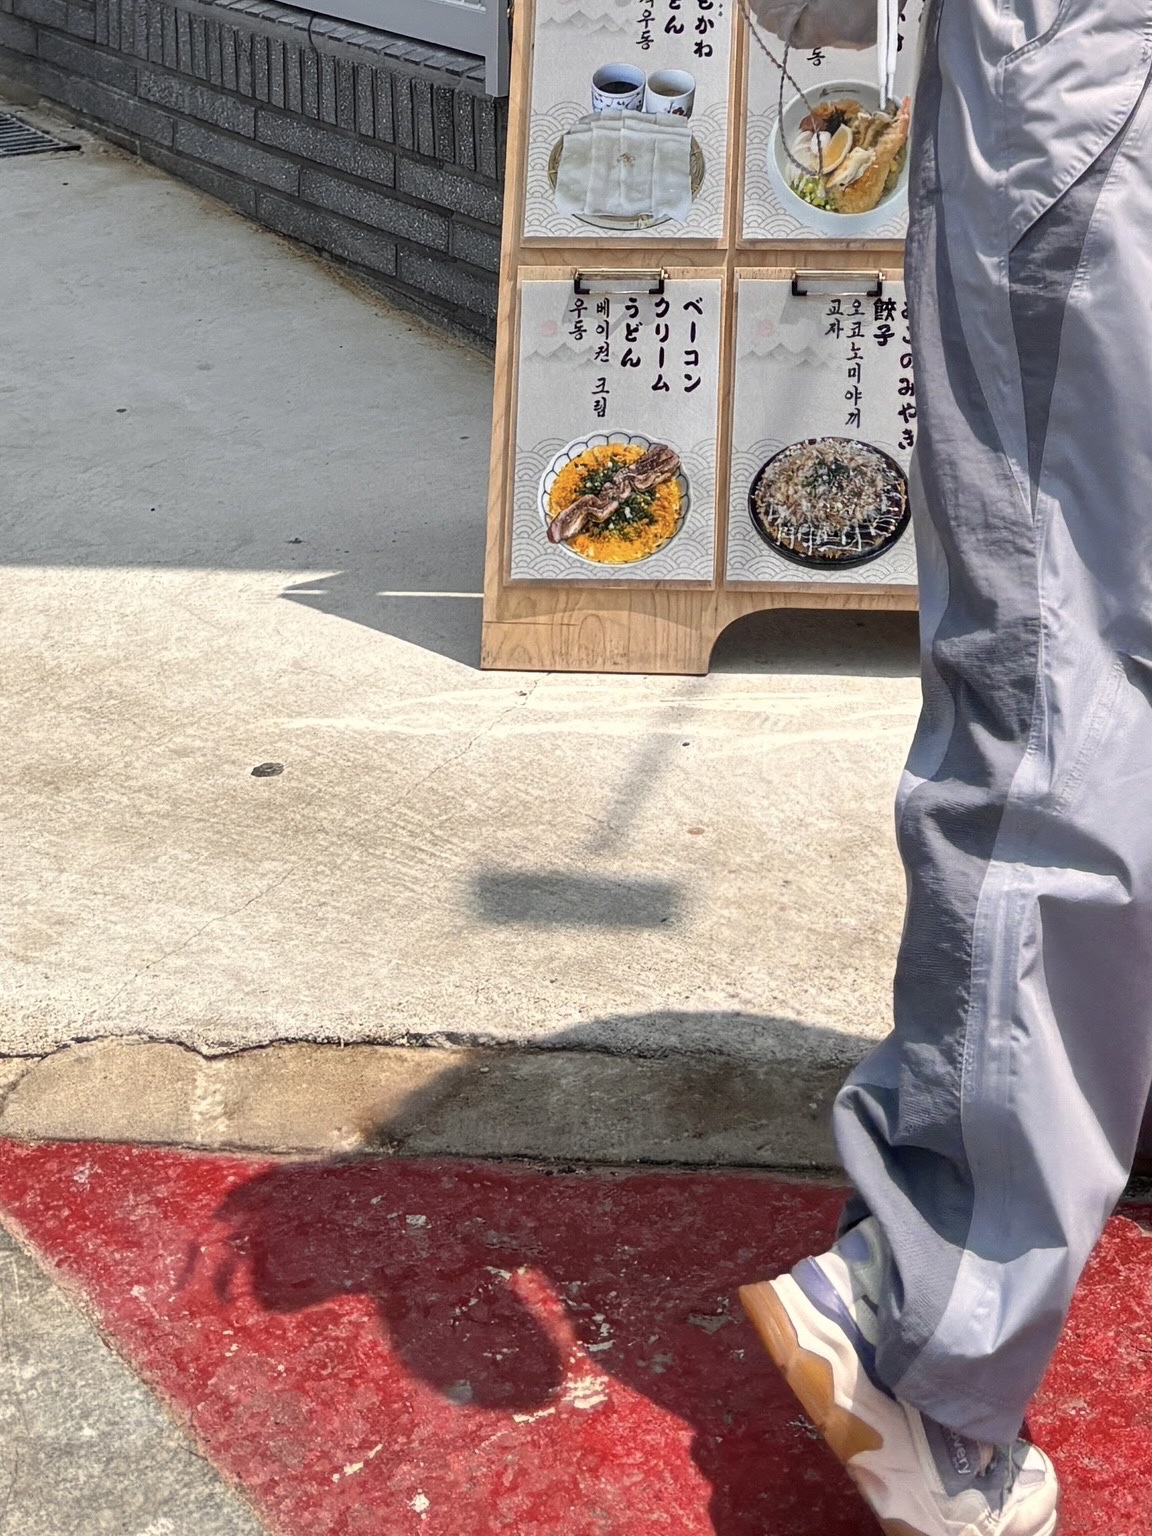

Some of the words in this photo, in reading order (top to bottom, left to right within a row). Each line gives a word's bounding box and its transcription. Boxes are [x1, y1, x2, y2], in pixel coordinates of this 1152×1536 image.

[569, 298, 588, 340] 우동
[621, 297, 642, 367] うどん
[652, 297, 670, 392] クリーム
[683, 297, 703, 392] ベーコン
[825, 299, 844, 339] 교자
[592, 377, 610, 417] 크림
[843, 299, 865, 428] 오코노미야끼
